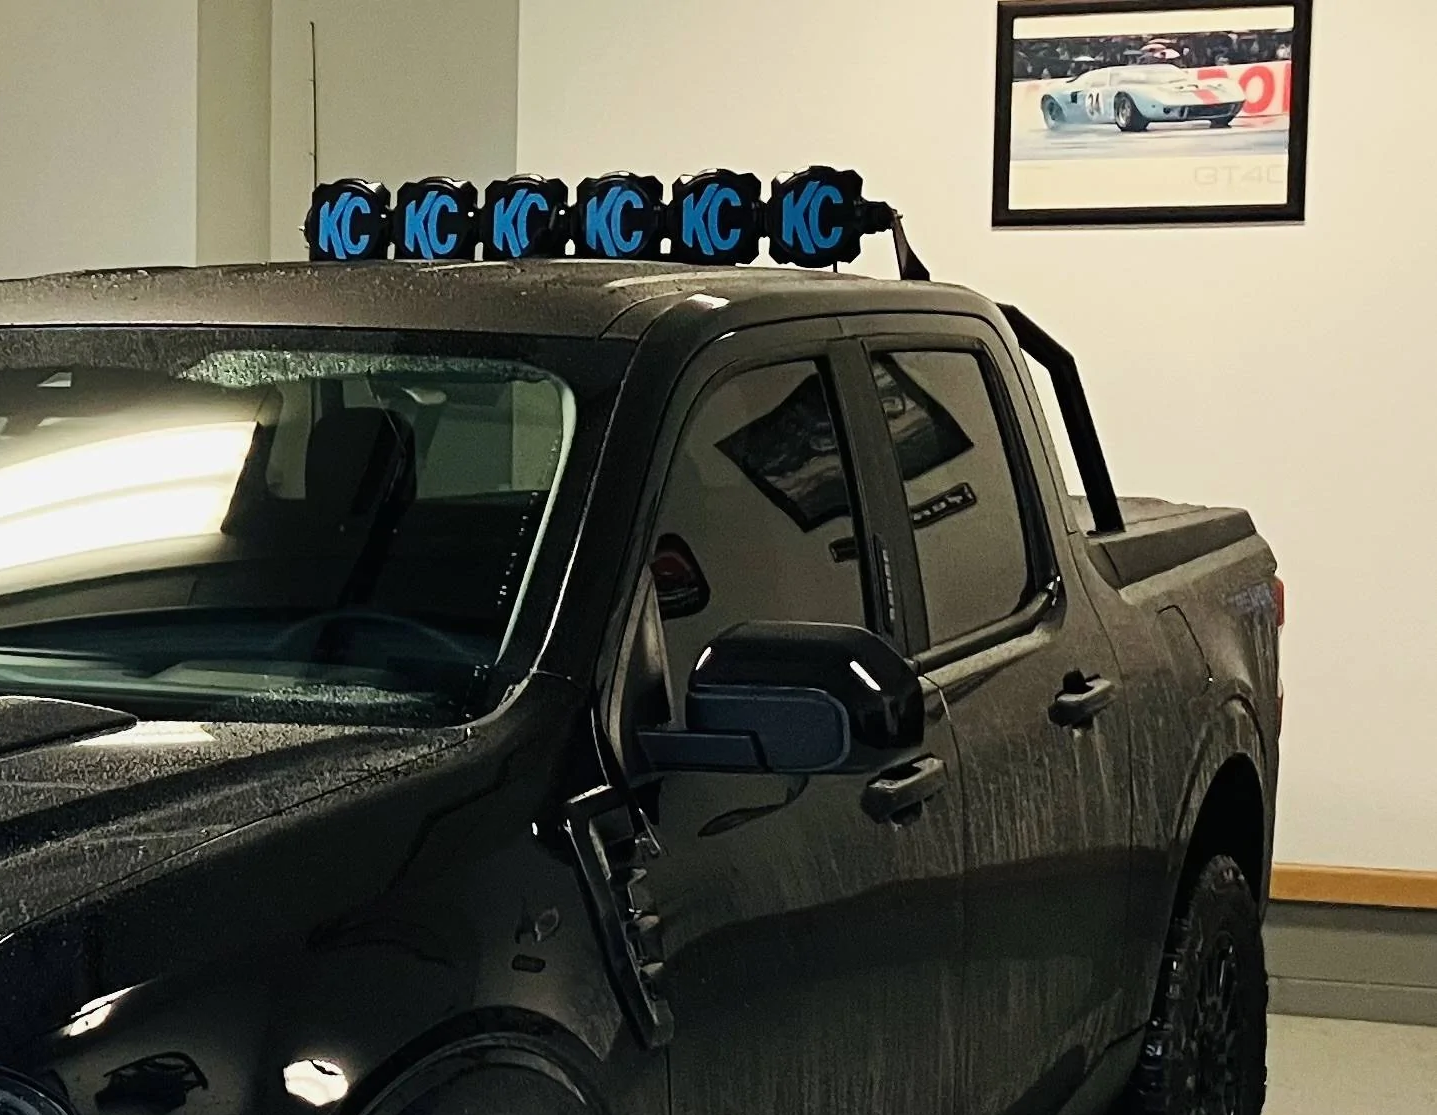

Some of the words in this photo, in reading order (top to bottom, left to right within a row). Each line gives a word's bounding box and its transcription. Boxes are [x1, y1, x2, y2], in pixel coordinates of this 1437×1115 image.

[319, 192, 370, 259] KC
[405, 190, 457, 259] KC
[493, 188, 549, 258] KC
[586, 186, 644, 257] KC
[682, 183, 742, 256] KC
[782, 181, 843, 254] KC
